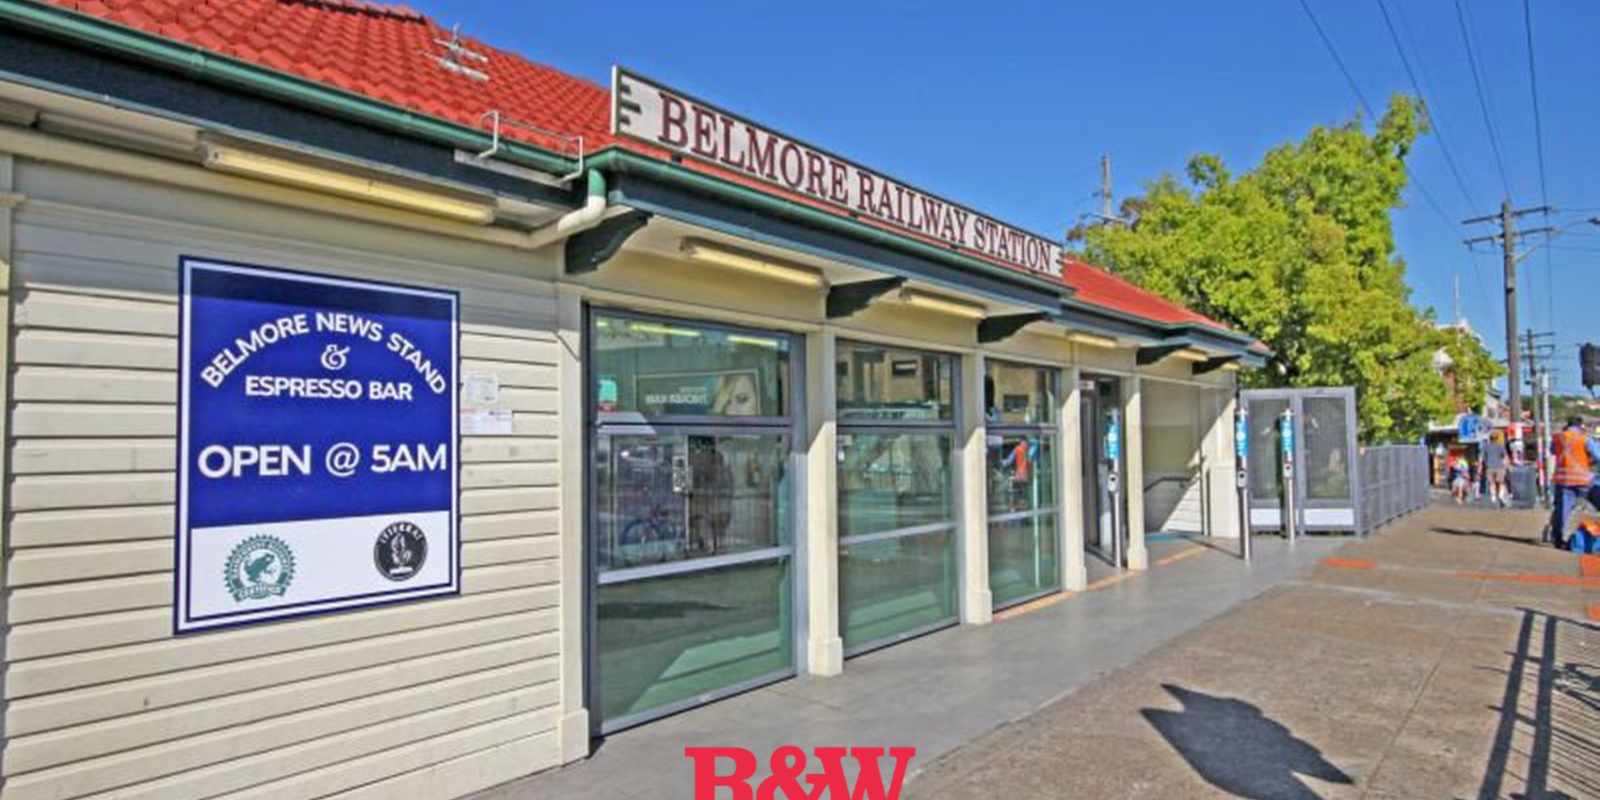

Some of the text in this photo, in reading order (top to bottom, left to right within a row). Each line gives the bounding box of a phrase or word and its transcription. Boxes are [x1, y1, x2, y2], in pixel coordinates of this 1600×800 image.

[658, 92, 1051, 272] BELMORE RAILWAY STATION
[201, 314, 309, 388] BELMORE
[315, 312, 384, 343] NEWS
[386, 333, 446, 395] STAND
[321, 344, 350, 370] &
[245, 376, 412, 401] ESPRESSO BAR
[198, 442, 447, 478] OPEN @ 5AM
